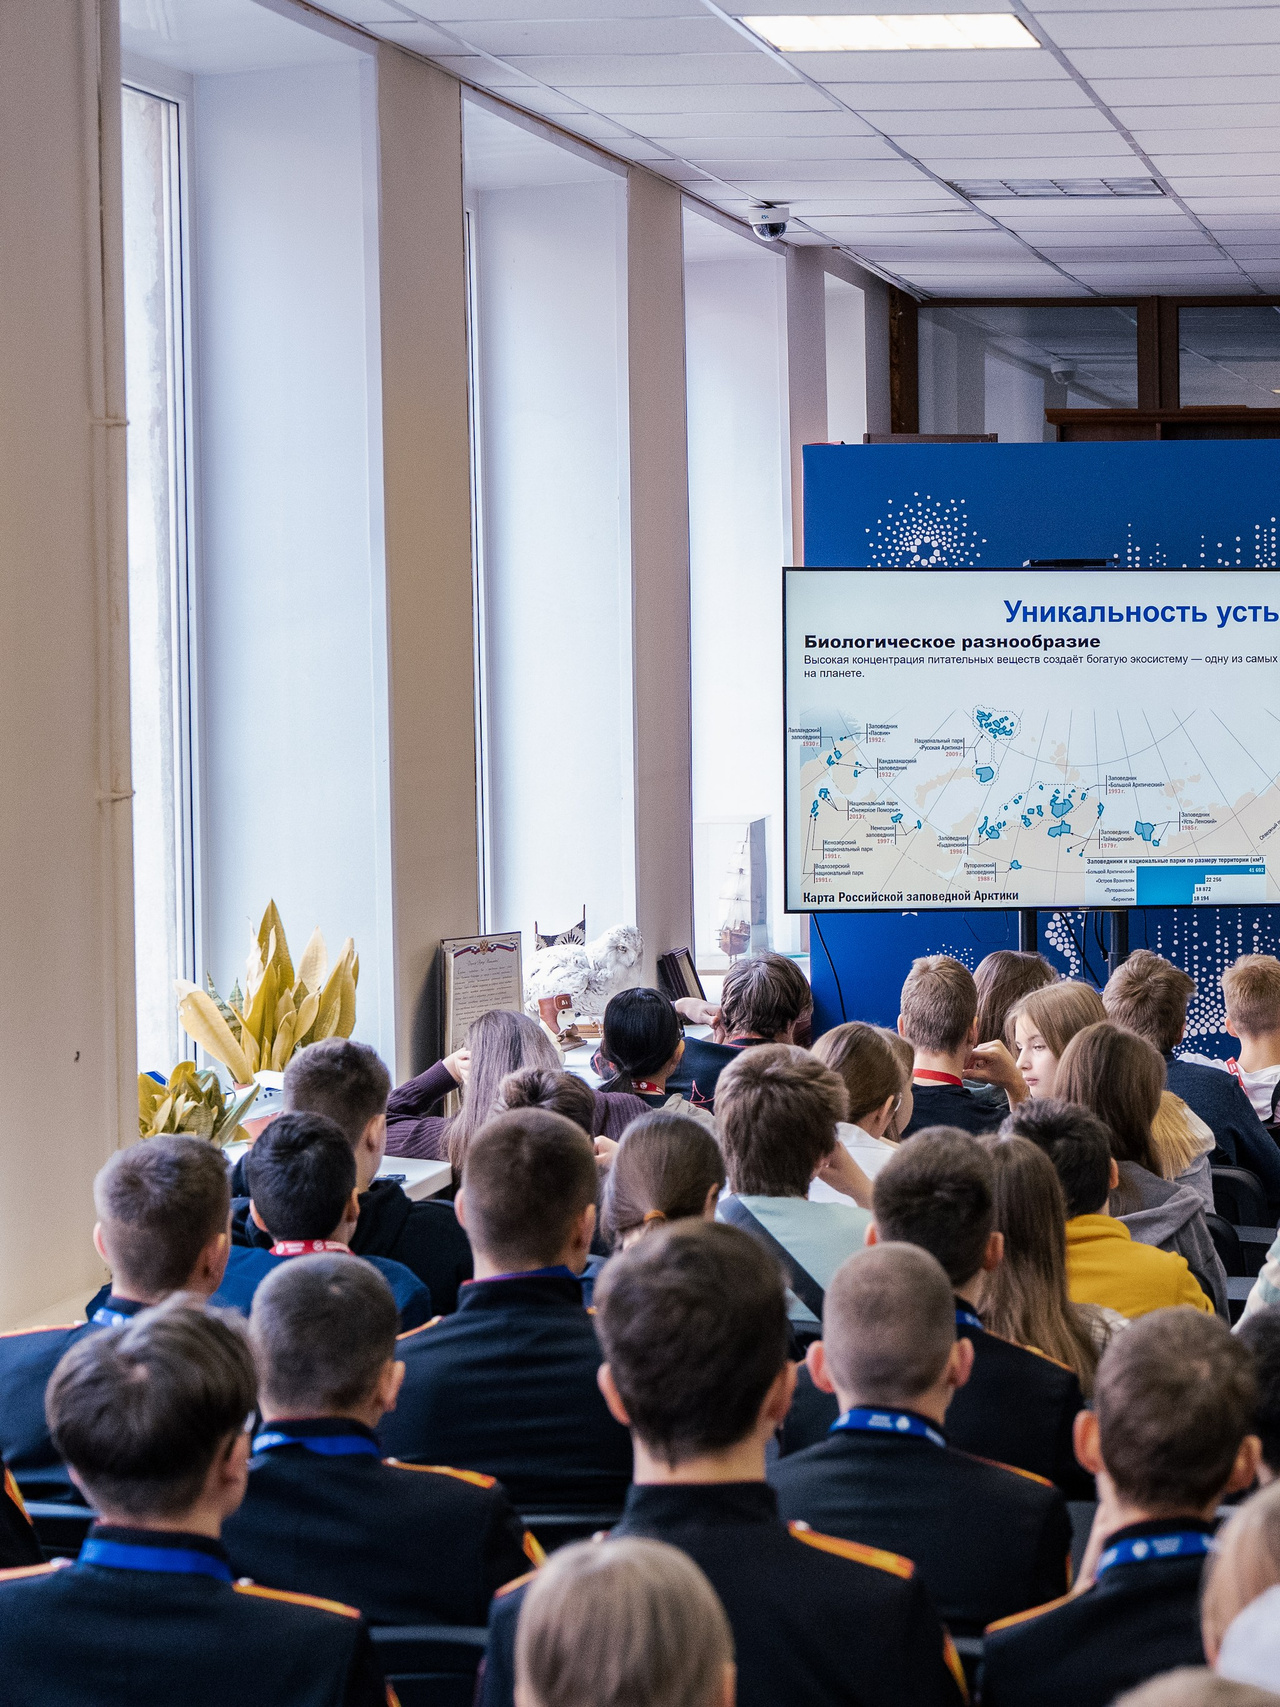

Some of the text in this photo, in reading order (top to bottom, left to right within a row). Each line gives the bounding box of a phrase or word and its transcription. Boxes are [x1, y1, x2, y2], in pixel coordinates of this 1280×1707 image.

[1004, 600, 1208, 623] Уникальность
[804, 634, 1100, 651] Биологическое разнообразие
[804, 655, 849, 665] Высокая
[852, 656, 924, 665] концентрация
[928, 656, 994, 665] питательных
[997, 656, 1040, 665] веществ
[1043, 654, 1084, 665] создаёт
[1086, 654, 1128, 665] богатую
[1130, 656, 1188, 665] экосистему
[1204, 656, 1228, 665] одну
[1232, 655, 1242, 663] из
[1246, 655, 1278, 663] самых
[820, 670, 864, 678] планете.
[802, 890, 1018, 904] Карта Российской заповедной Арктики
